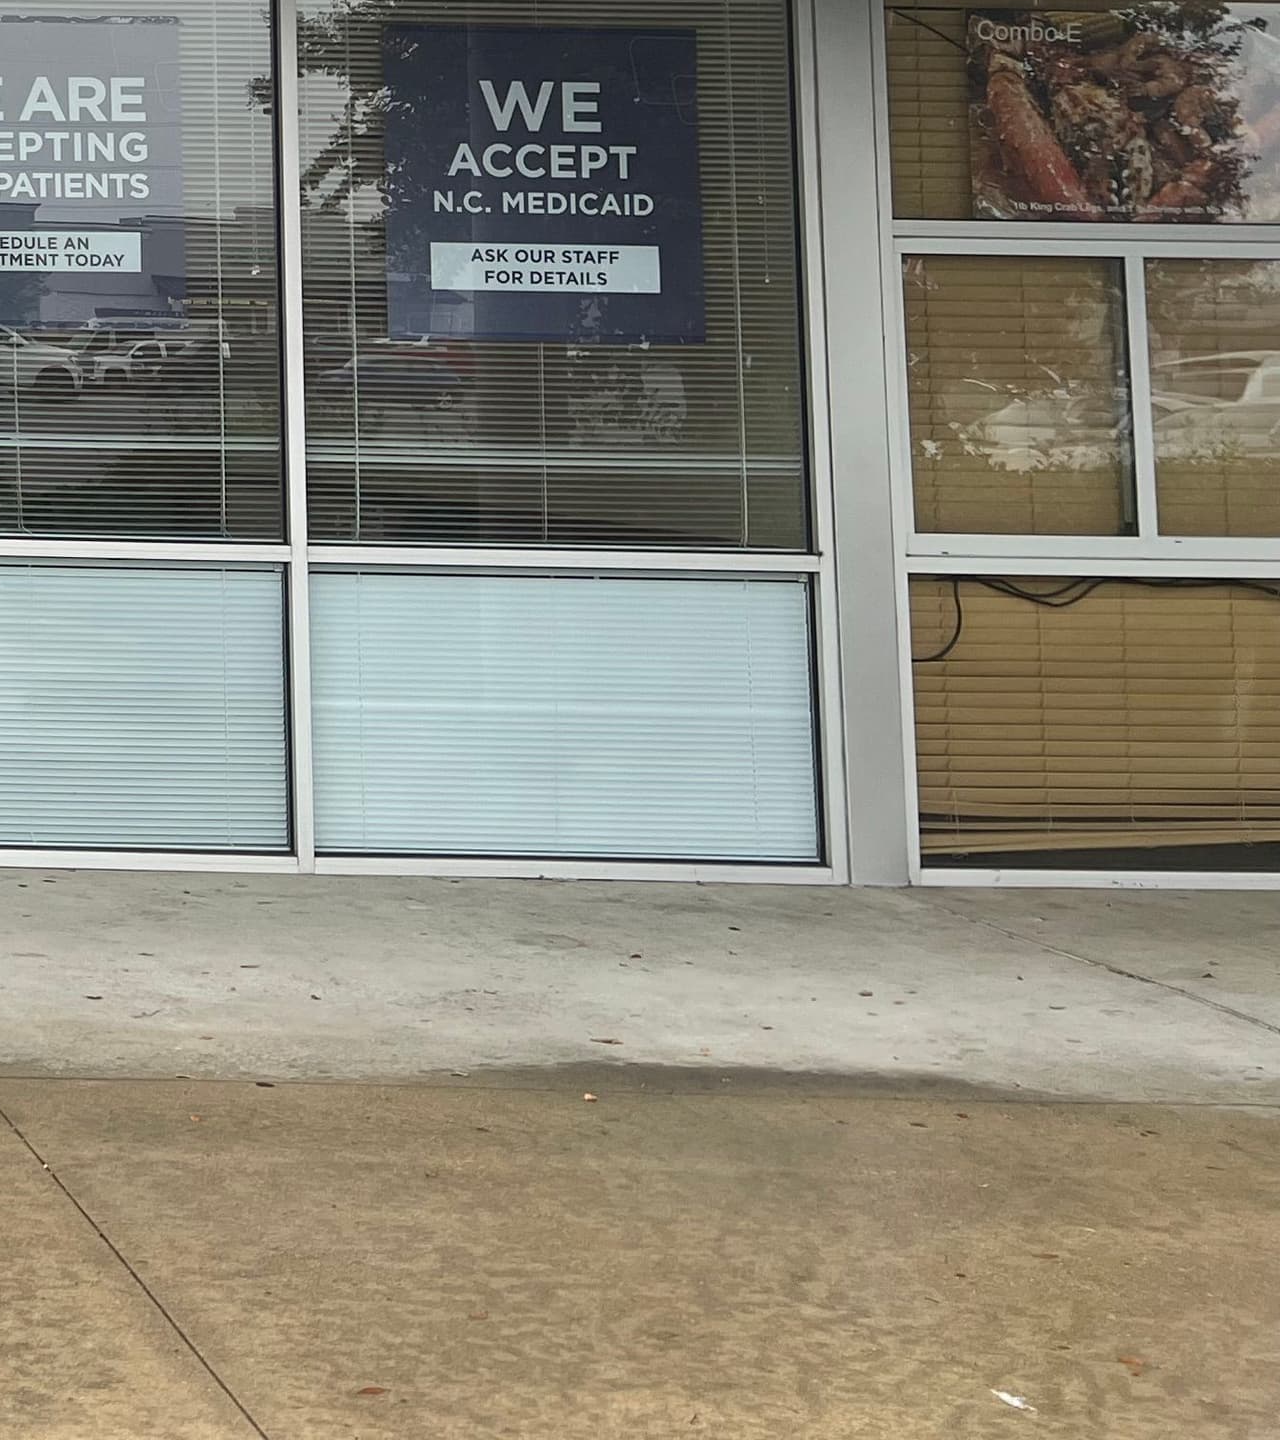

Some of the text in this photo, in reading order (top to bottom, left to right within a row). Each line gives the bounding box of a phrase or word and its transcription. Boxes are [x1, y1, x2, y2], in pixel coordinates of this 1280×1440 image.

[977, 20, 1057, 42] Combo
[19, 76, 147, 122] ARE
[479, 79, 603, 133] WE
[447, 143, 637, 180] ACCEPT
[433, 190, 655, 217] N.C. MEDICAID
[64, 237, 90, 250] AN
[64, 253, 125, 267] TODAY
[471, 247, 620, 265] ASK OUR STAFF
[484, 270, 608, 286] FOR DETAILS
